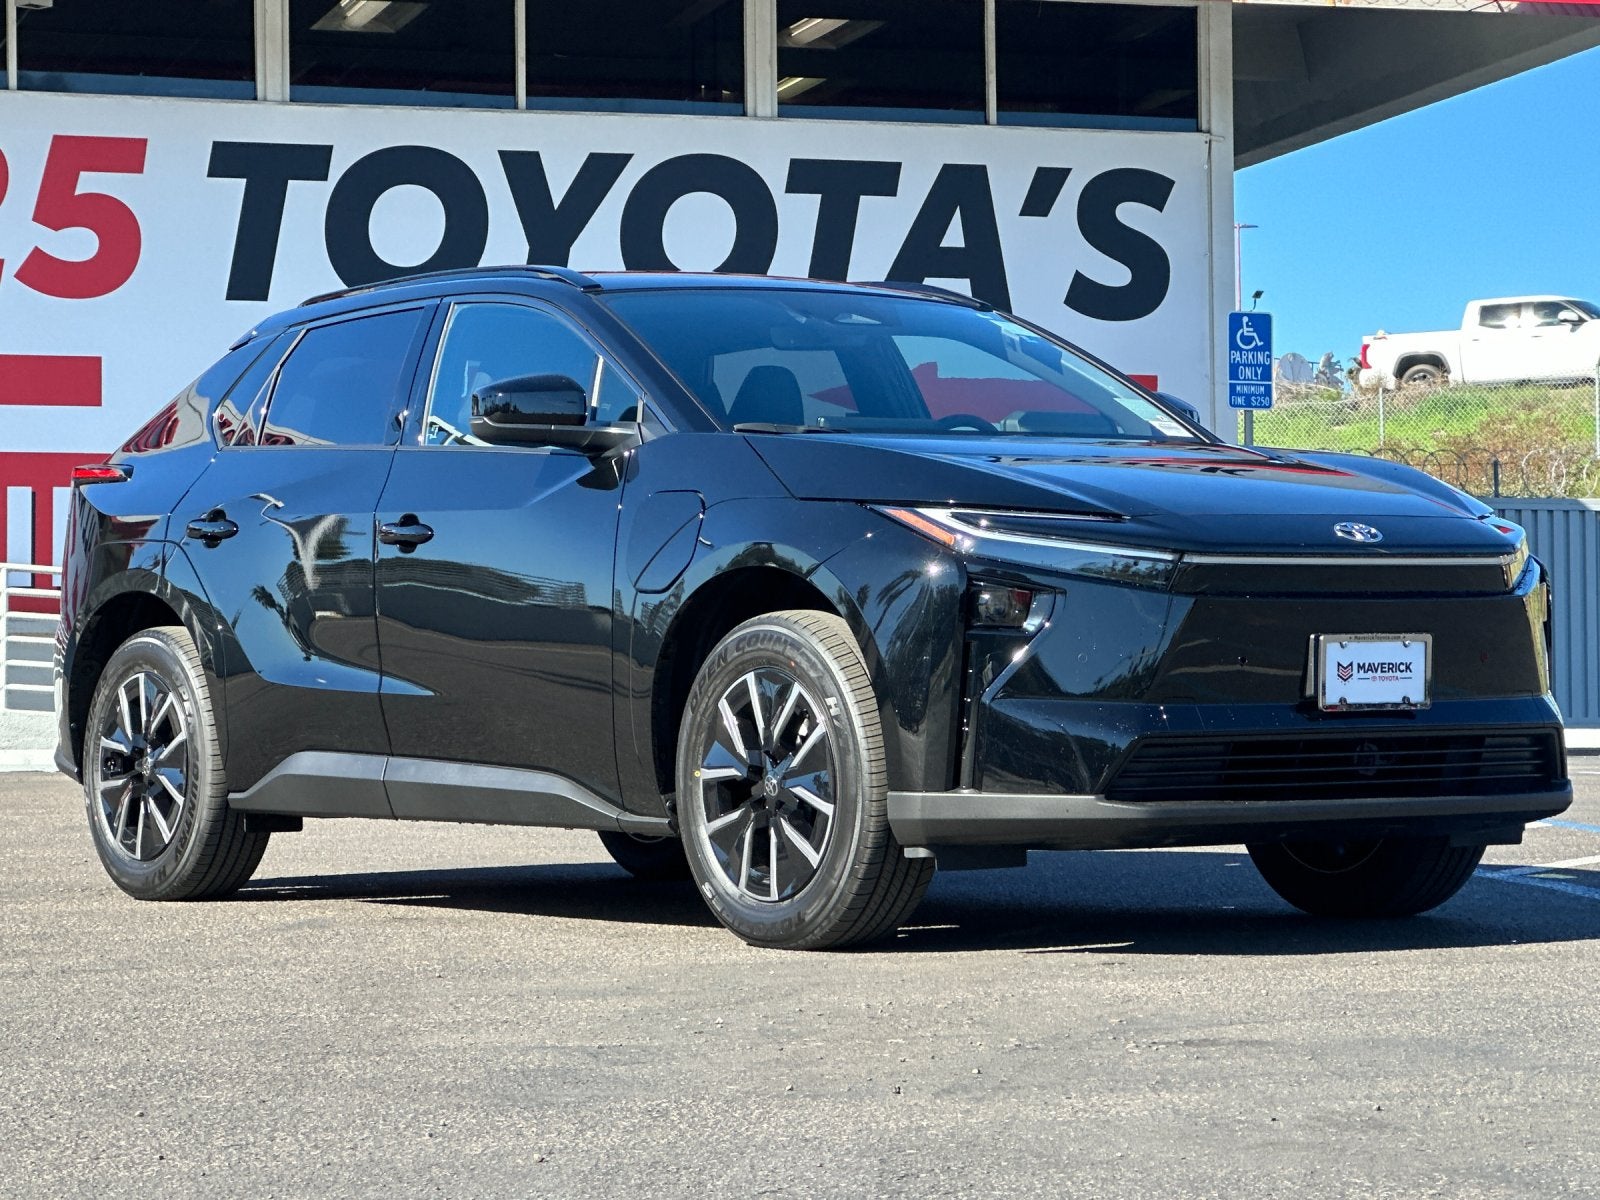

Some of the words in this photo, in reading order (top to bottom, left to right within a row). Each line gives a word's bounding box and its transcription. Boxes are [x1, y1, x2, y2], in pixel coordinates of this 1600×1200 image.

[0, 133, 148, 299] 5
[207, 140, 1176, 321] TOYOTA'S
[1230, 350, 1271, 365] PARKING
[1238, 366, 1263, 380] ONLY
[1236, 385, 1265, 395] MINIMUM
[1231, 396, 1246, 406] FINE
[1250, 396, 1270, 407] $250
[1357, 661, 1413, 674] MAVERICK
